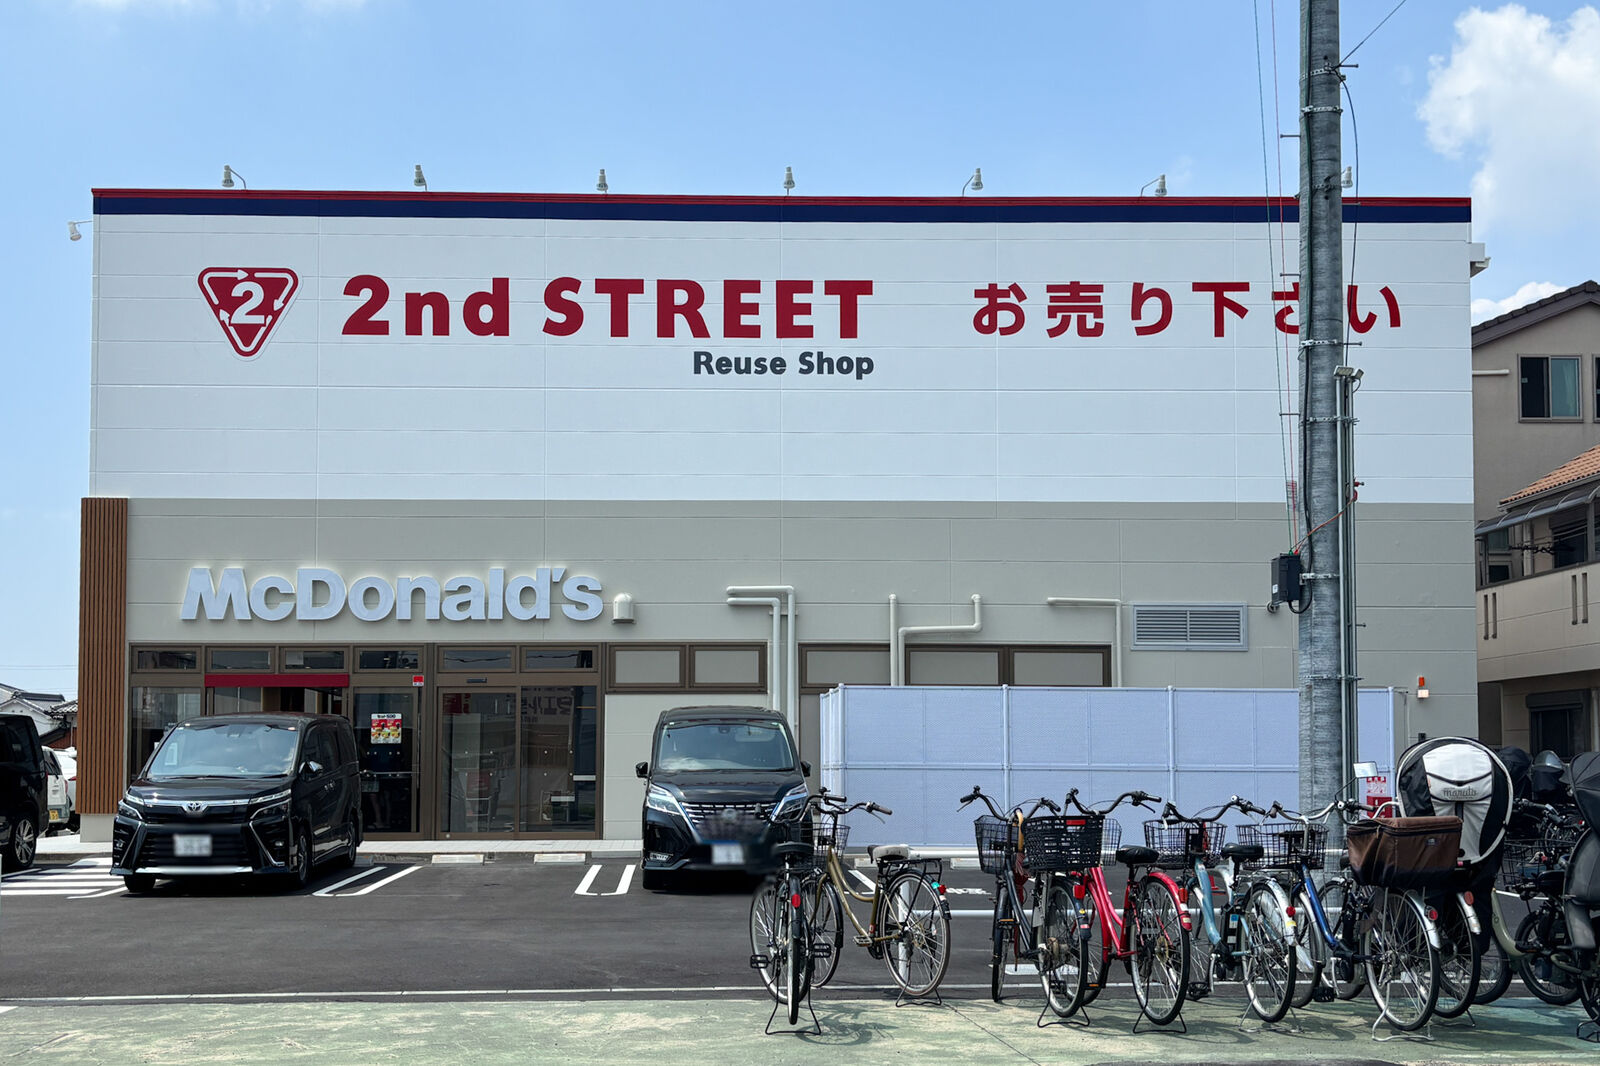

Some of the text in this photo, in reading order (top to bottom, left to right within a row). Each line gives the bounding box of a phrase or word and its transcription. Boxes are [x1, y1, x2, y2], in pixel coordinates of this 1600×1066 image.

[231, 281, 264, 324] 2
[342, 274, 873, 339] 2nd STREET
[693, 350, 875, 381] Reuse Shop
[180, 565, 604, 621] McDonald's
